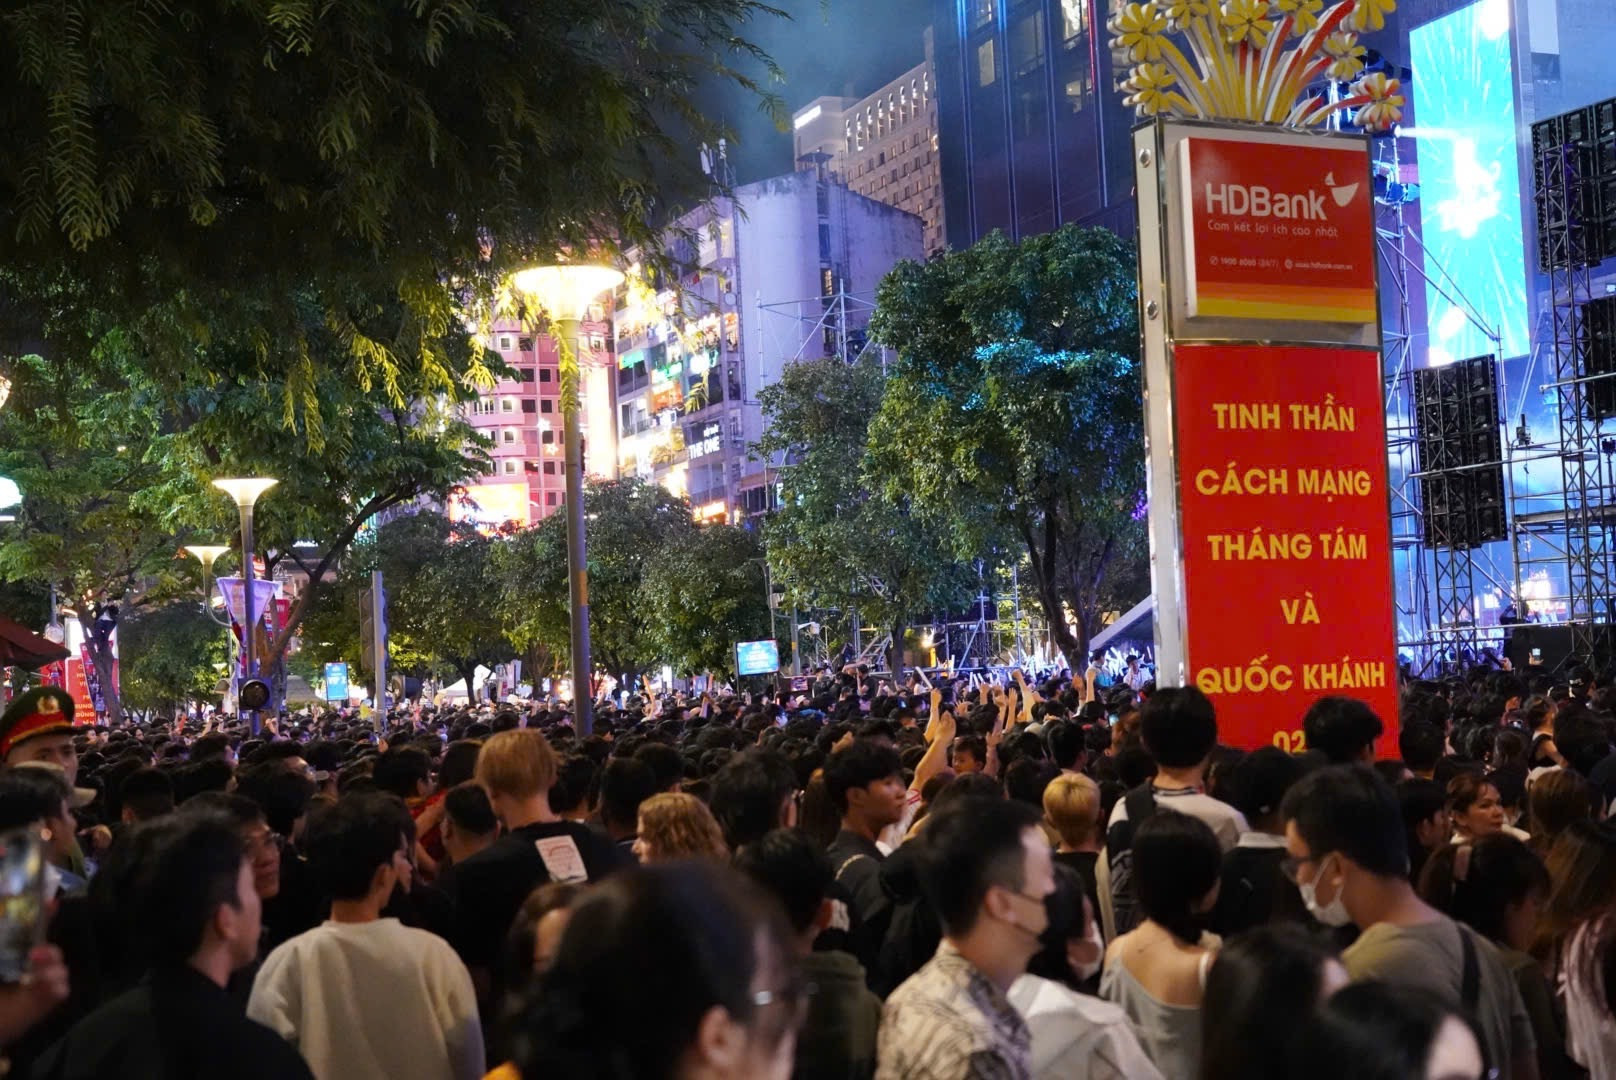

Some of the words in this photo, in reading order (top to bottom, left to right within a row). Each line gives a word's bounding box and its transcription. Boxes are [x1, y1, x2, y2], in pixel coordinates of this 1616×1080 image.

[1205, 182, 1328, 220] HDBank
[1207, 220, 1230, 232] Cam
[1292, 226, 1311, 236] cao
[1213, 403, 1280, 429] TINH
[1289, 392, 1355, 432] THẦN
[1196, 461, 1289, 495] CÁCH
[1298, 469, 1372, 503] MẠNG
[1207, 526, 1313, 560] THÁNG
[1320, 526, 1368, 560] TÁM
[1279, 591, 1321, 625] VÀ
[1196, 653, 1293, 694] QUỐC
[1303, 655, 1386, 690] KHÁNH
